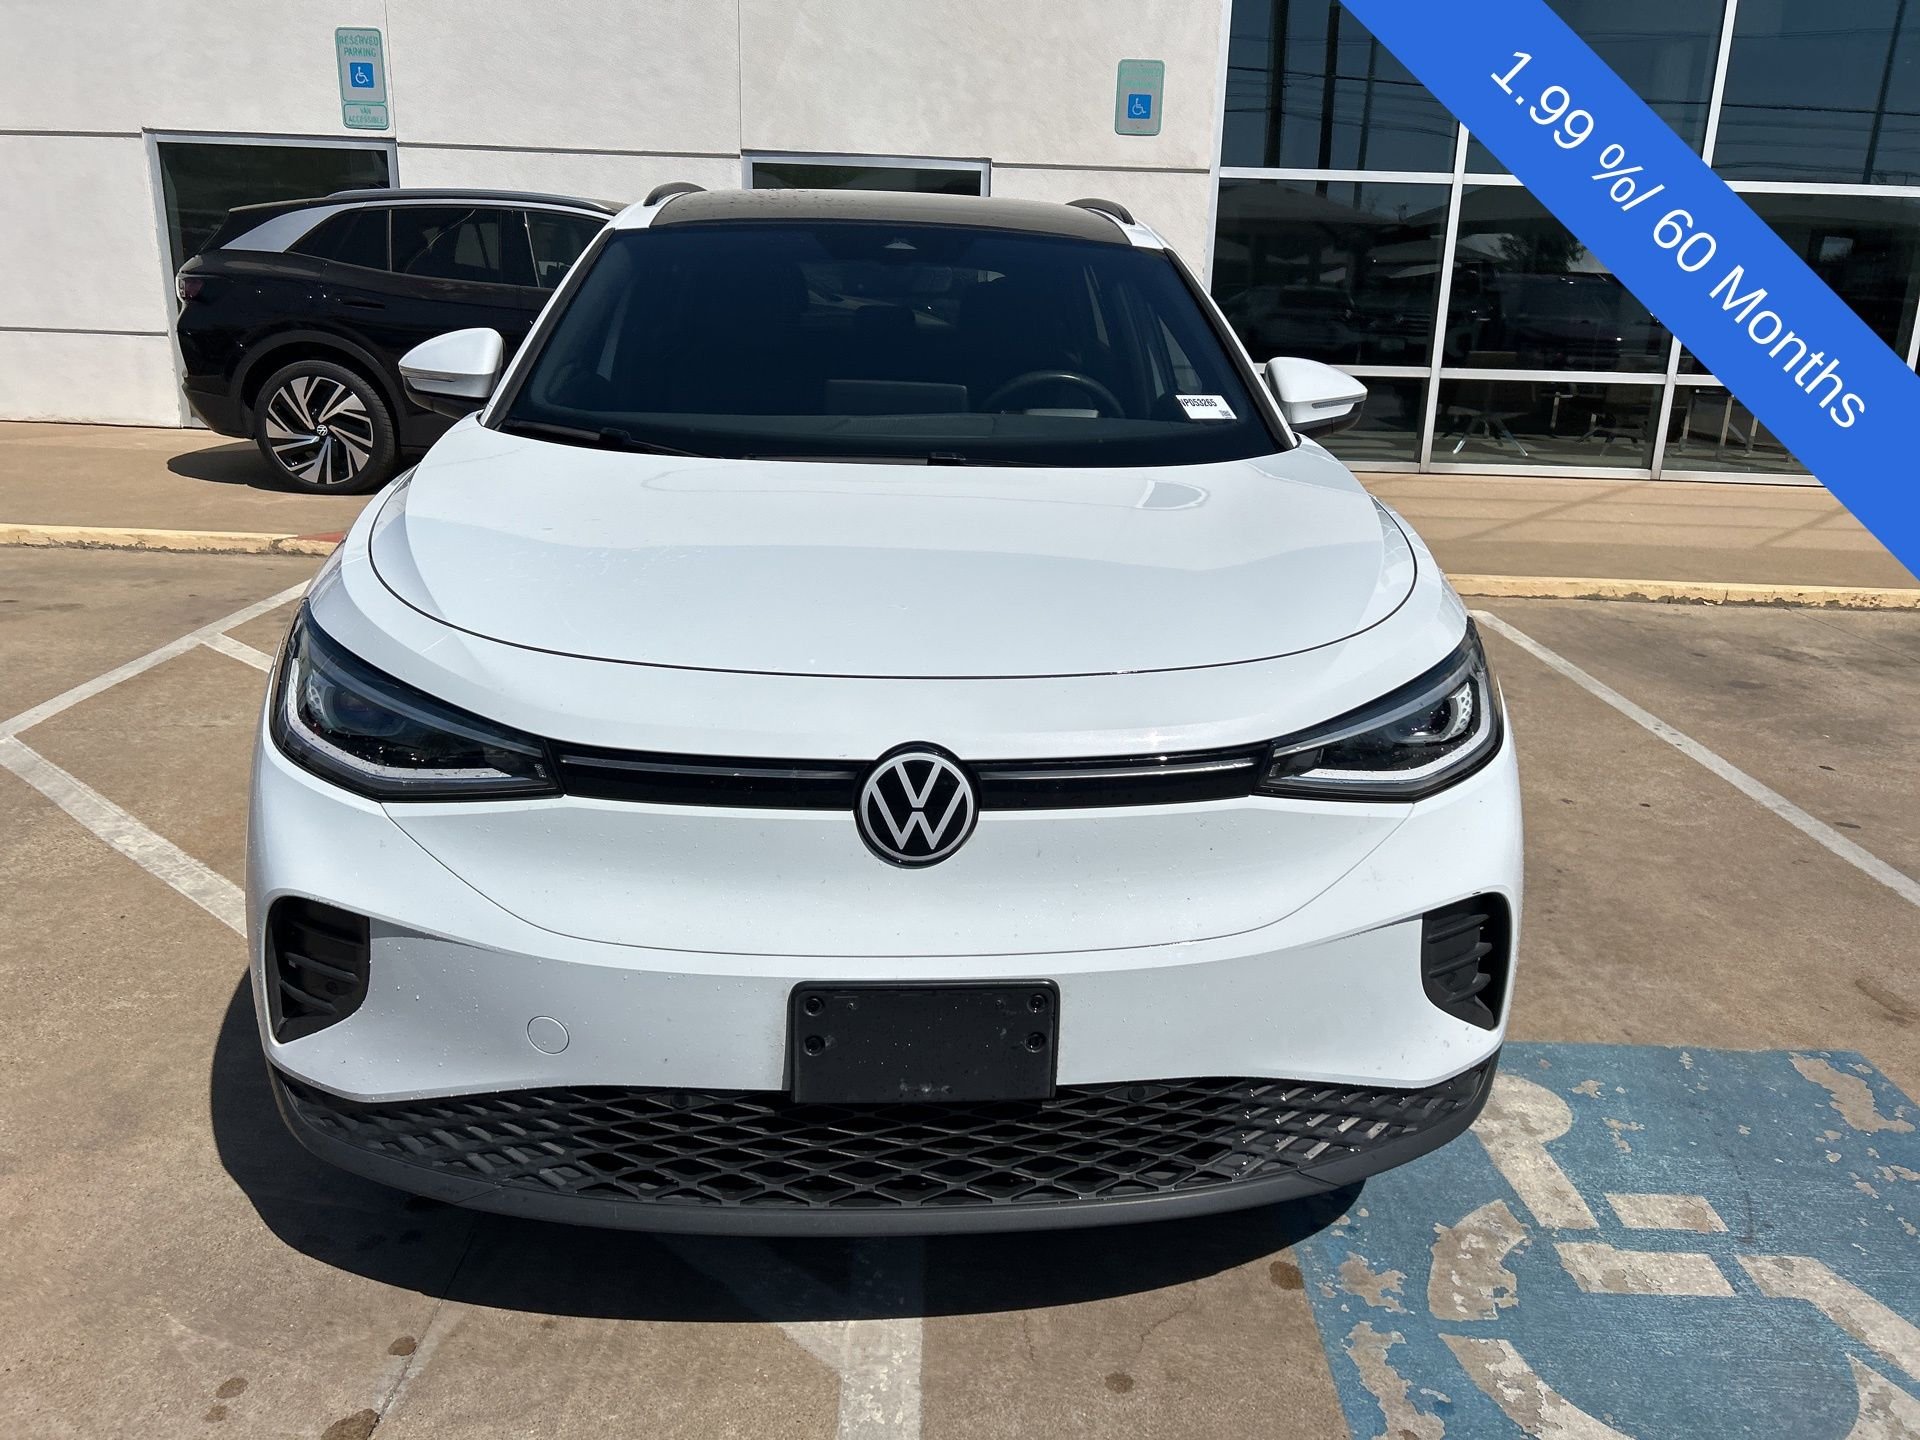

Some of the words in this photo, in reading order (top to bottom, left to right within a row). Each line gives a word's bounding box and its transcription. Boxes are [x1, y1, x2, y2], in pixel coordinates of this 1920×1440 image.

[338, 35, 379, 46] RESERVED
[344, 48, 376, 57] PARKING
[864, 755, 970, 855] VW
